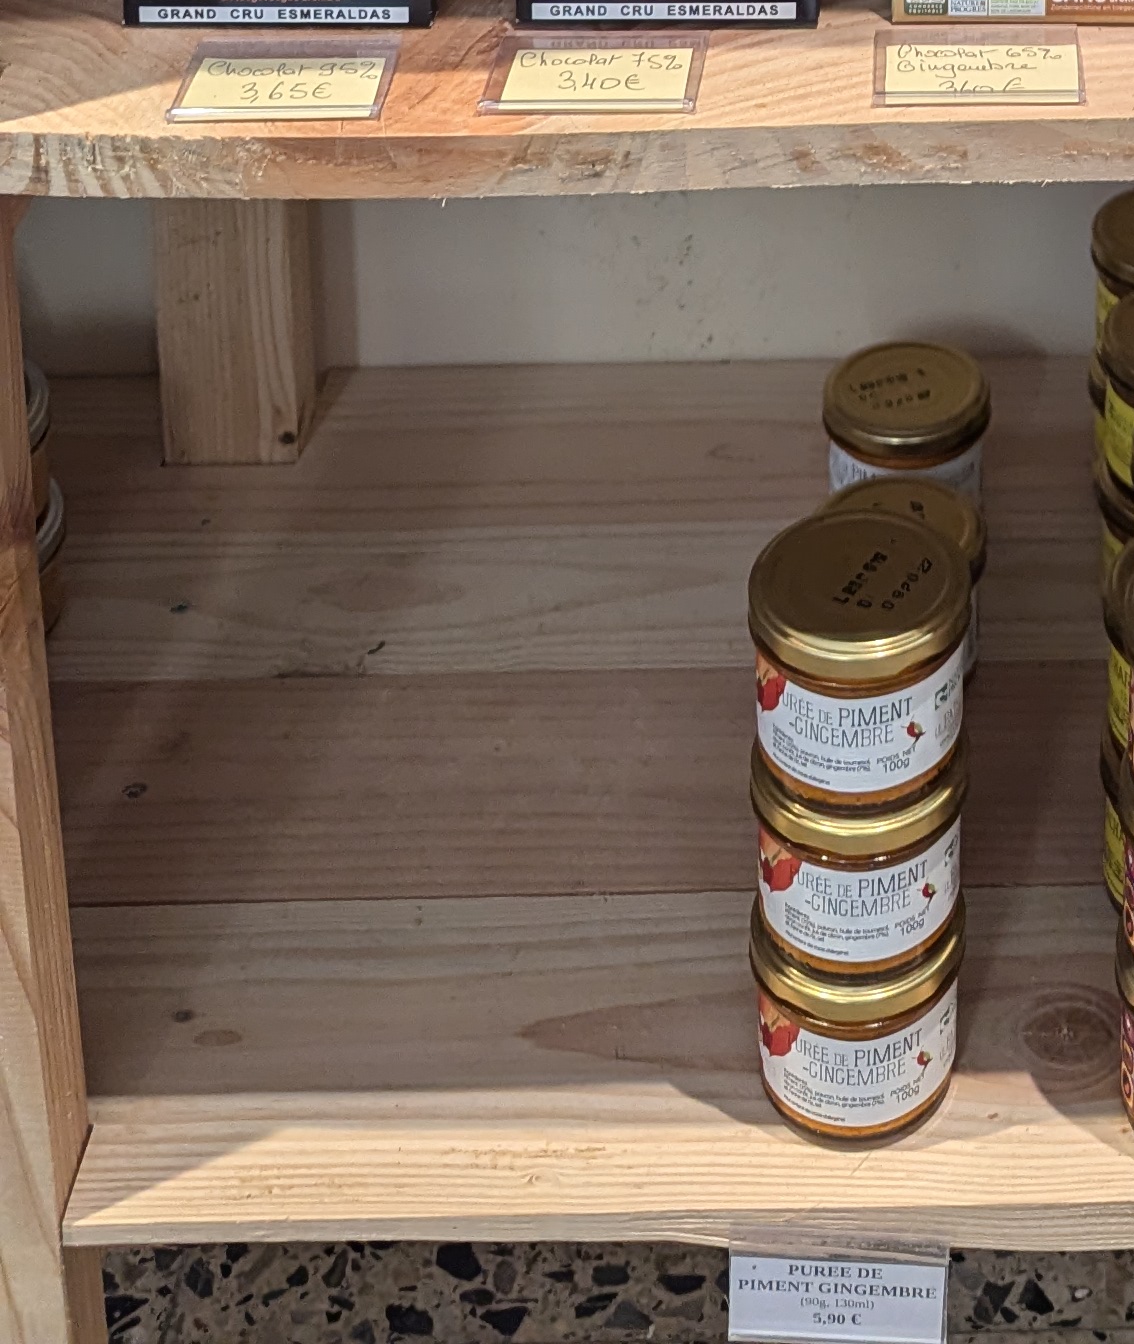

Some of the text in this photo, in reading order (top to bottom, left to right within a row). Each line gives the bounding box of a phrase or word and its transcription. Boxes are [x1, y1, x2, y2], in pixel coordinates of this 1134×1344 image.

[158, 9, 391, 20] GRAND CRU ESMERALDAS
[819, 709, 833, 725] DE
[838, 697, 912, 728] PIMENT
[788, 1264, 883, 1280] PUREE DE
[739, 1279, 937, 1299] PIMENT GINGEMBRE
